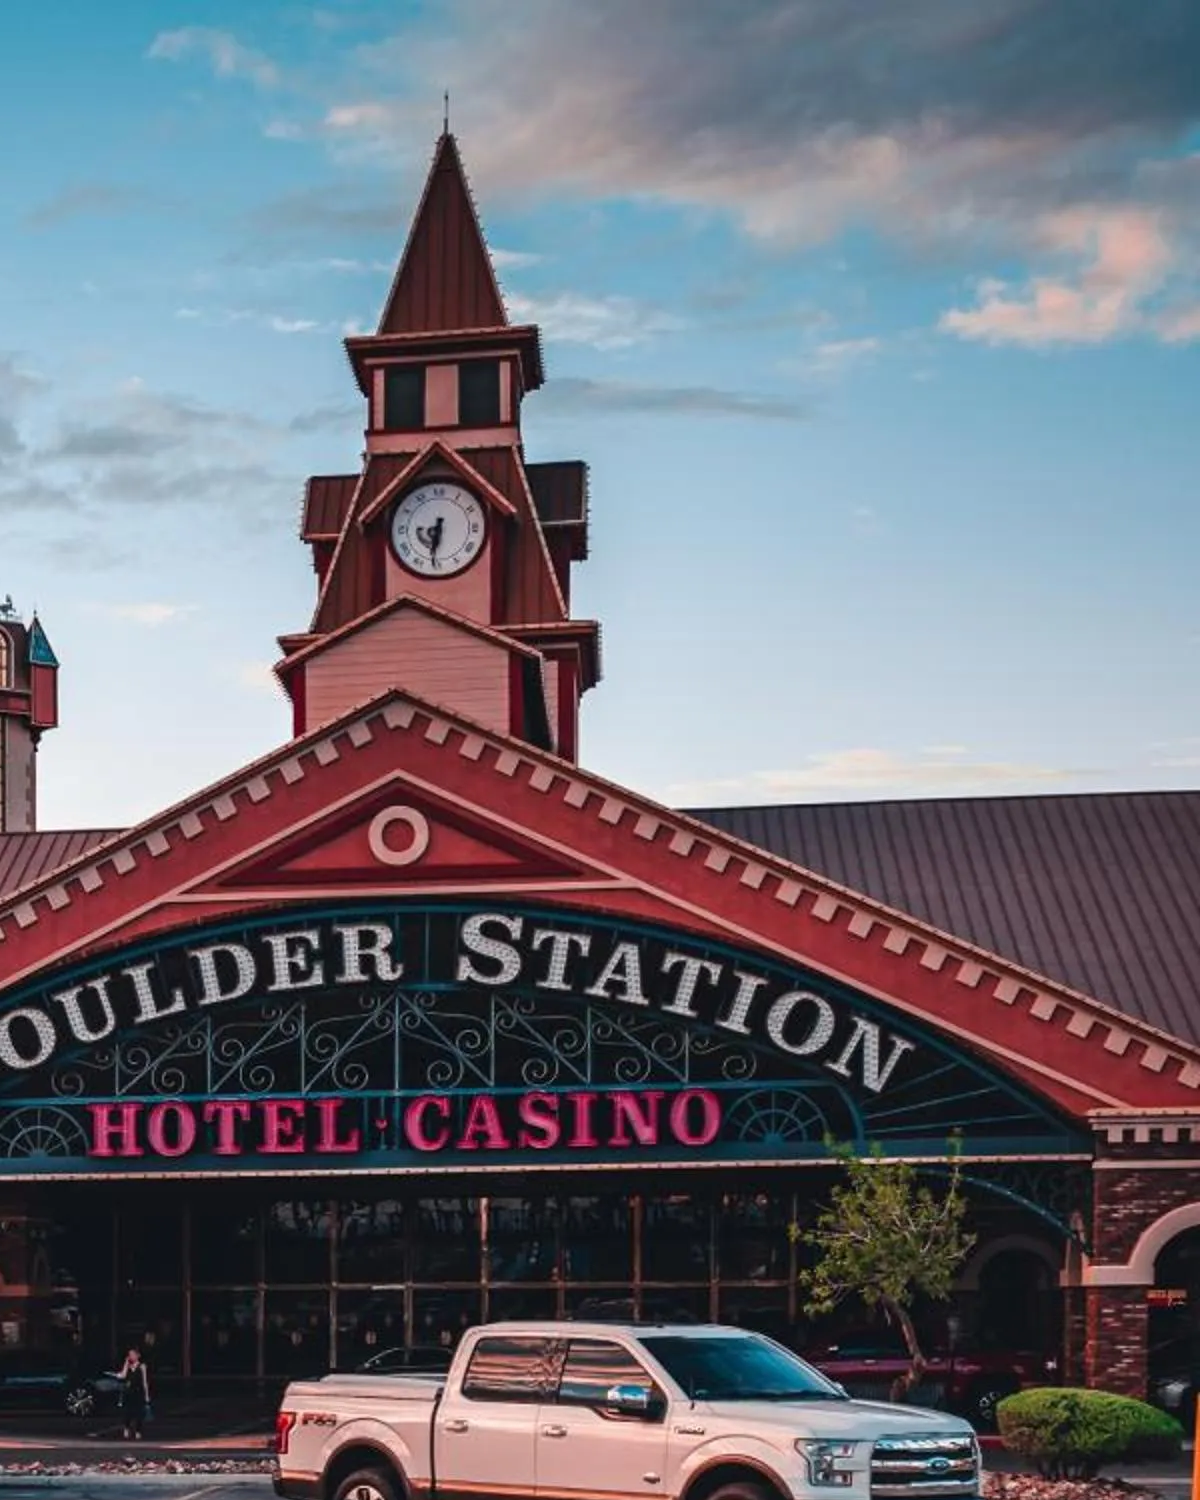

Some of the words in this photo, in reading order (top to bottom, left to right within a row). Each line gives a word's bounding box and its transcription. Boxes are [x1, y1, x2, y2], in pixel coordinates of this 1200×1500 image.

[455, 912, 914, 1094] STATION
[86, 1097, 363, 1157] HOTEL
[402, 1087, 722, 1151] CASINO
